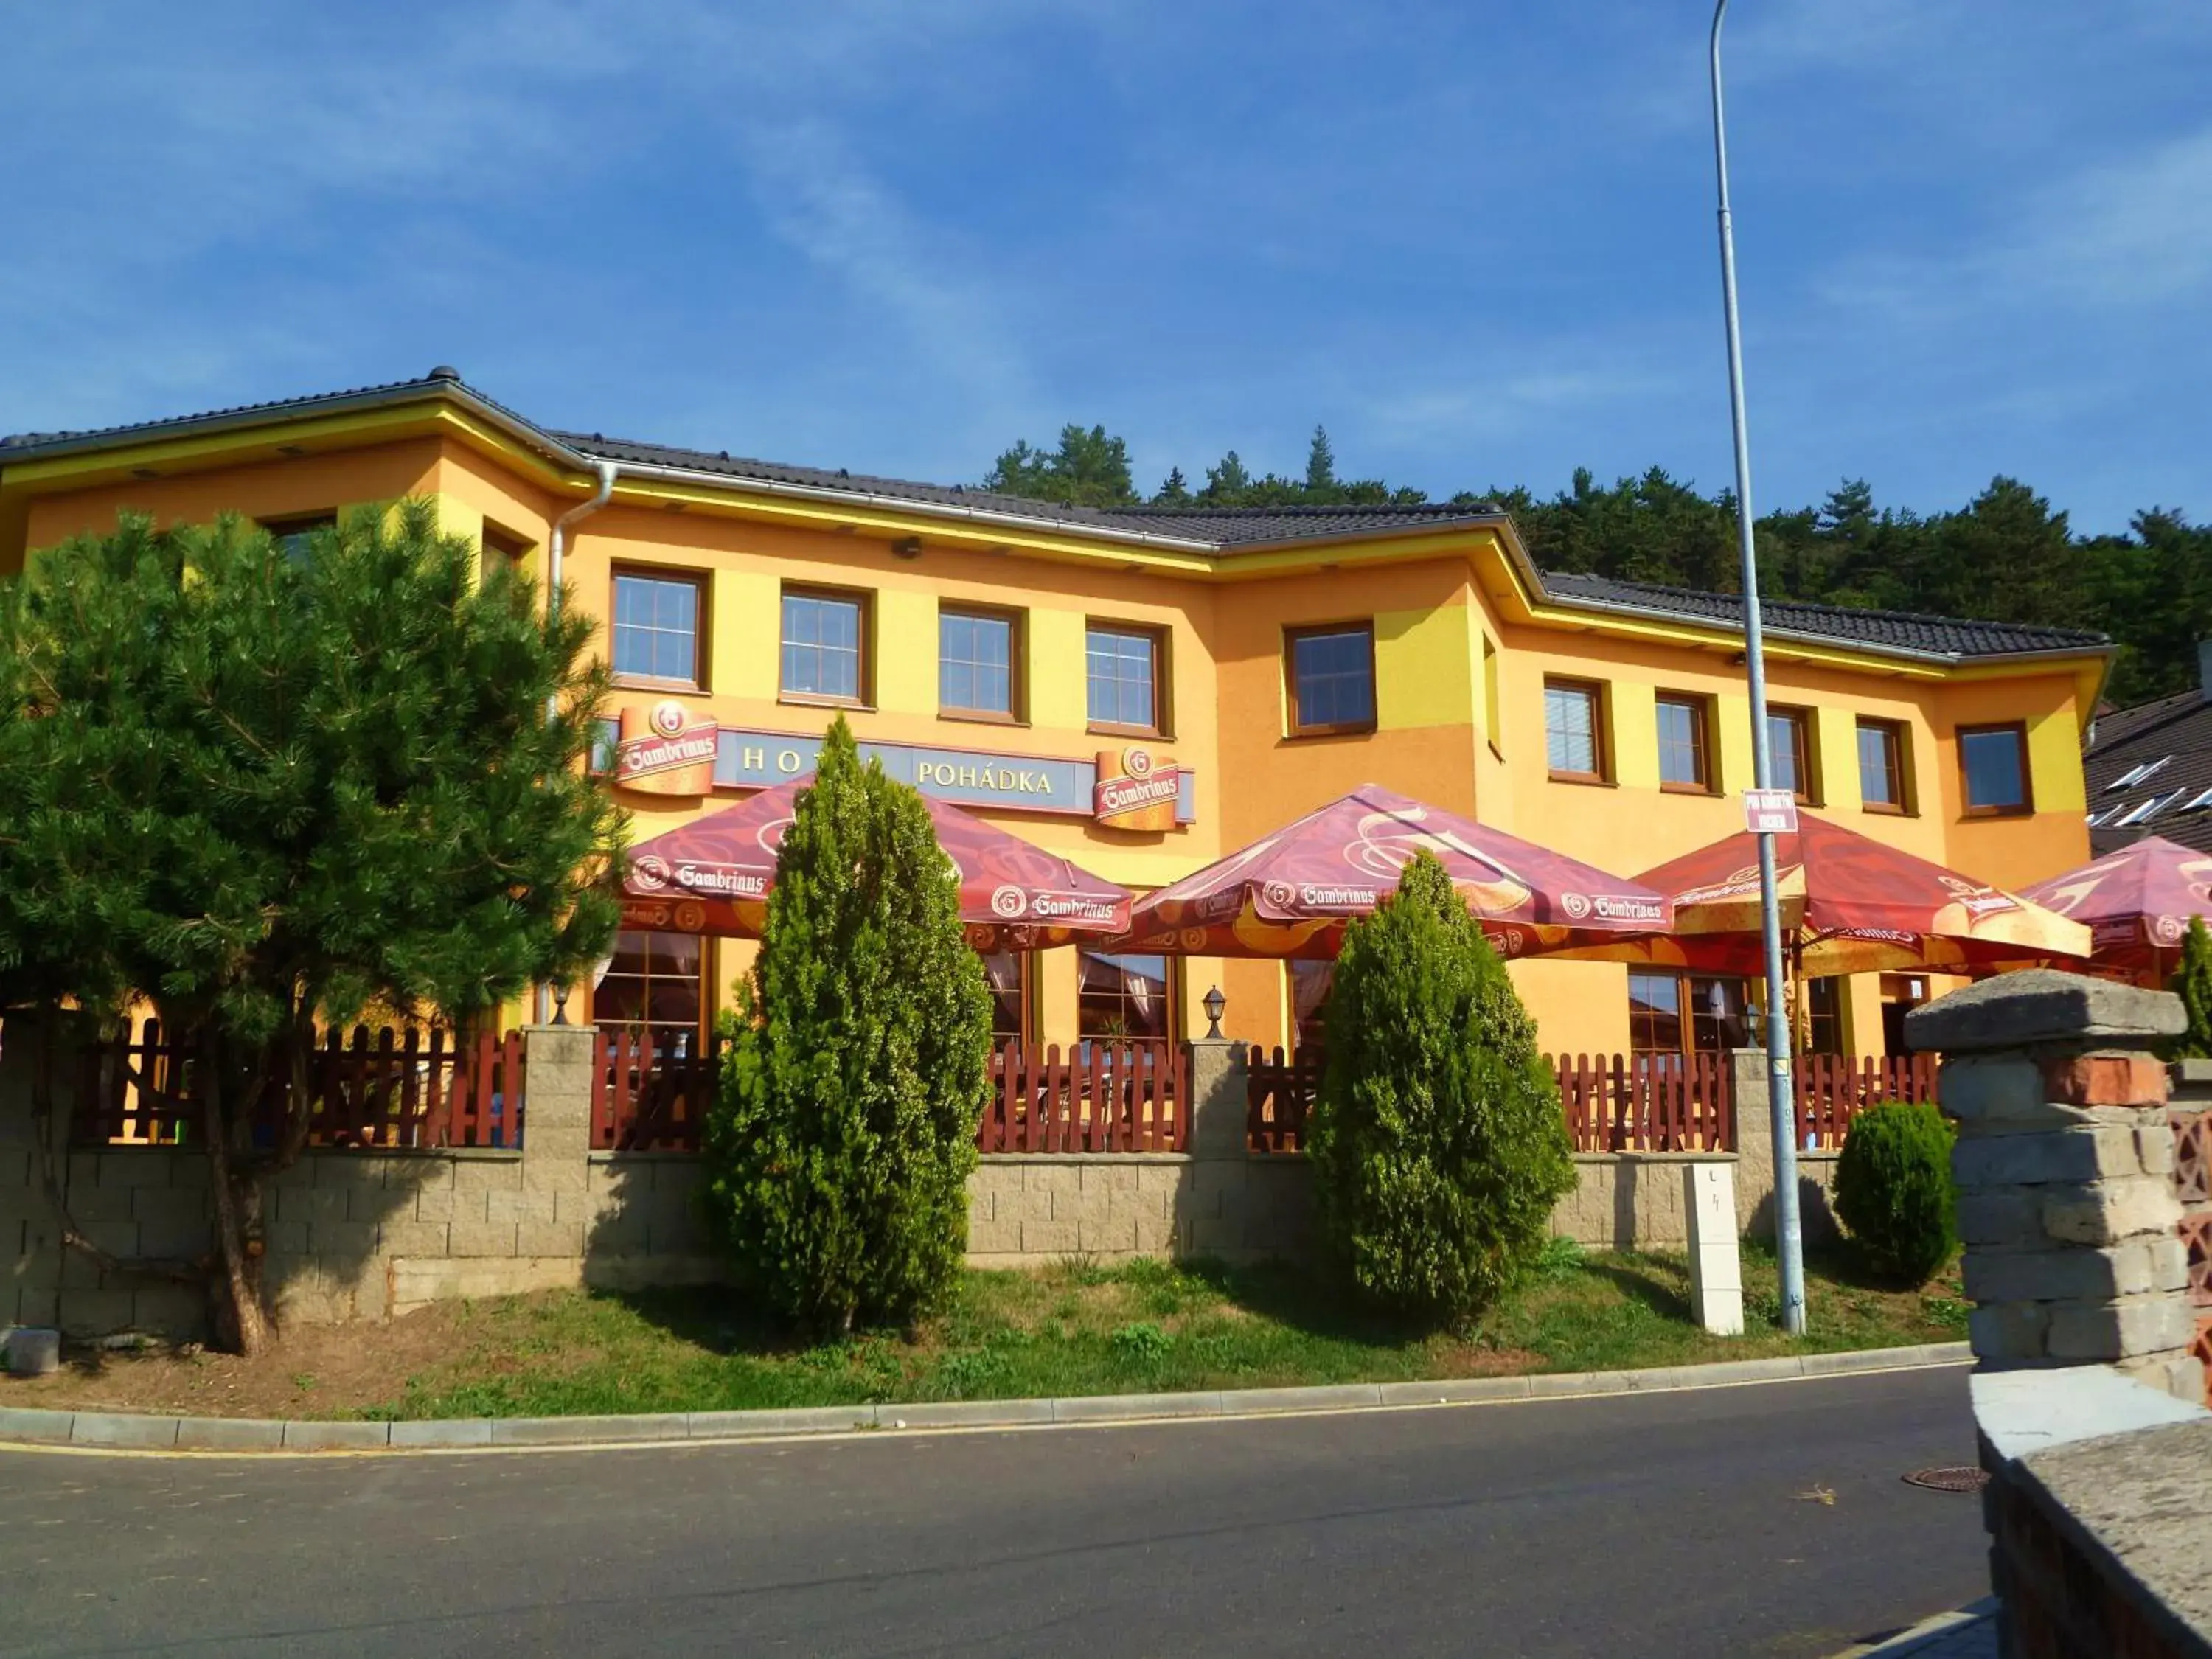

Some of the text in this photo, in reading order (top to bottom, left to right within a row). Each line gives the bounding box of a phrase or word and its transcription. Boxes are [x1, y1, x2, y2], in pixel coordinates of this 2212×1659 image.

[622, 737, 714, 771] Gambrinus
[919, 761, 1053, 794] POHÁDKA
[1101, 778, 1177, 809] Gambrinus
[675, 865, 765, 893] Gambrinus
[1032, 894, 1113, 919] Gambrinus
[1301, 885, 1376, 905] Gambrinus
